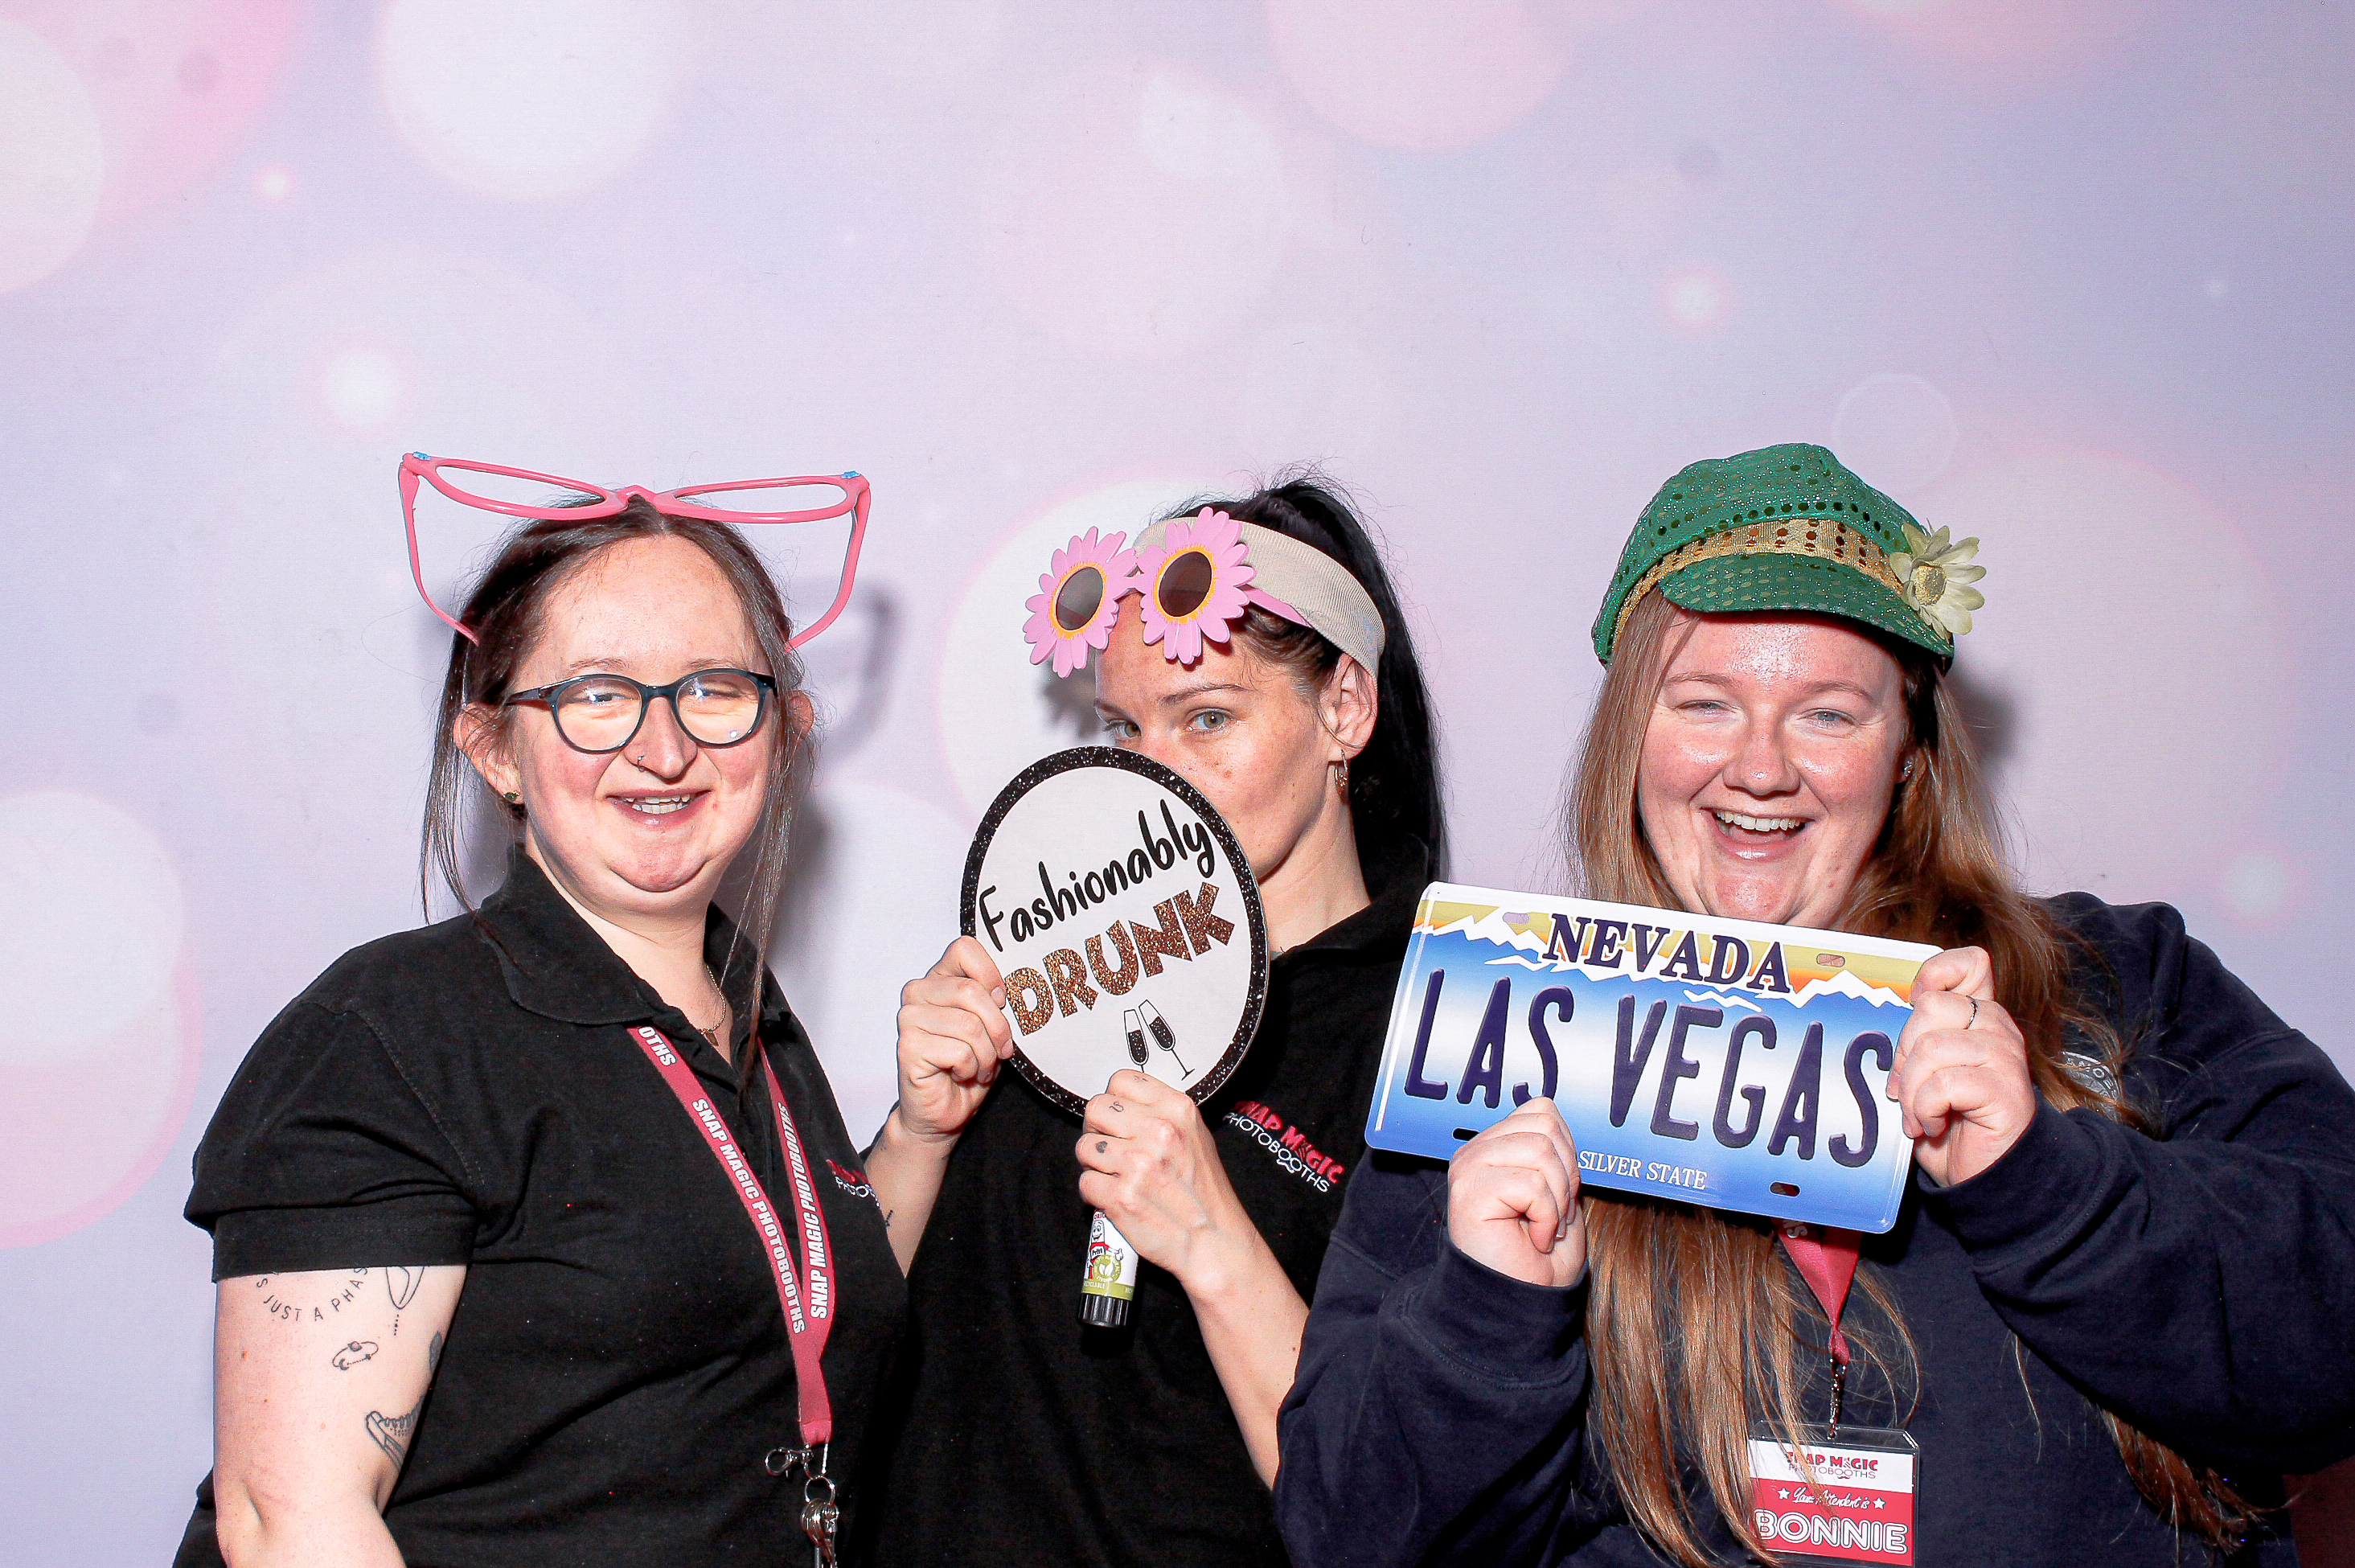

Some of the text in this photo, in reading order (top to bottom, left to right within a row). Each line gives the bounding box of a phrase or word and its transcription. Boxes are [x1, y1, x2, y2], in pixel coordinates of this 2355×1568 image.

[979, 799, 1215, 952] Fashionably
[1004, 881, 1235, 1036] DRUNK
[1542, 913, 1791, 994] NEVADA
[1404, 967, 1894, 1168] LAS VEGAS
[1223, 1111, 1331, 1193] PHOTOBOOTHS
[1578, 1150, 1708, 1191] SILVER STATE
[692, 1098, 806, 1335] SNAP MAGIC PHOTOBOOTHS
[777, 1102, 828, 1320] SNAP MAGIC PHOTOBOOTHS
[263, 1294, 302, 1322] JUST
[314, 1307, 324, 1321] A
[1754, 1508, 1908, 1555] BONNIE
[1860, 1496, 1871, 1510] is
